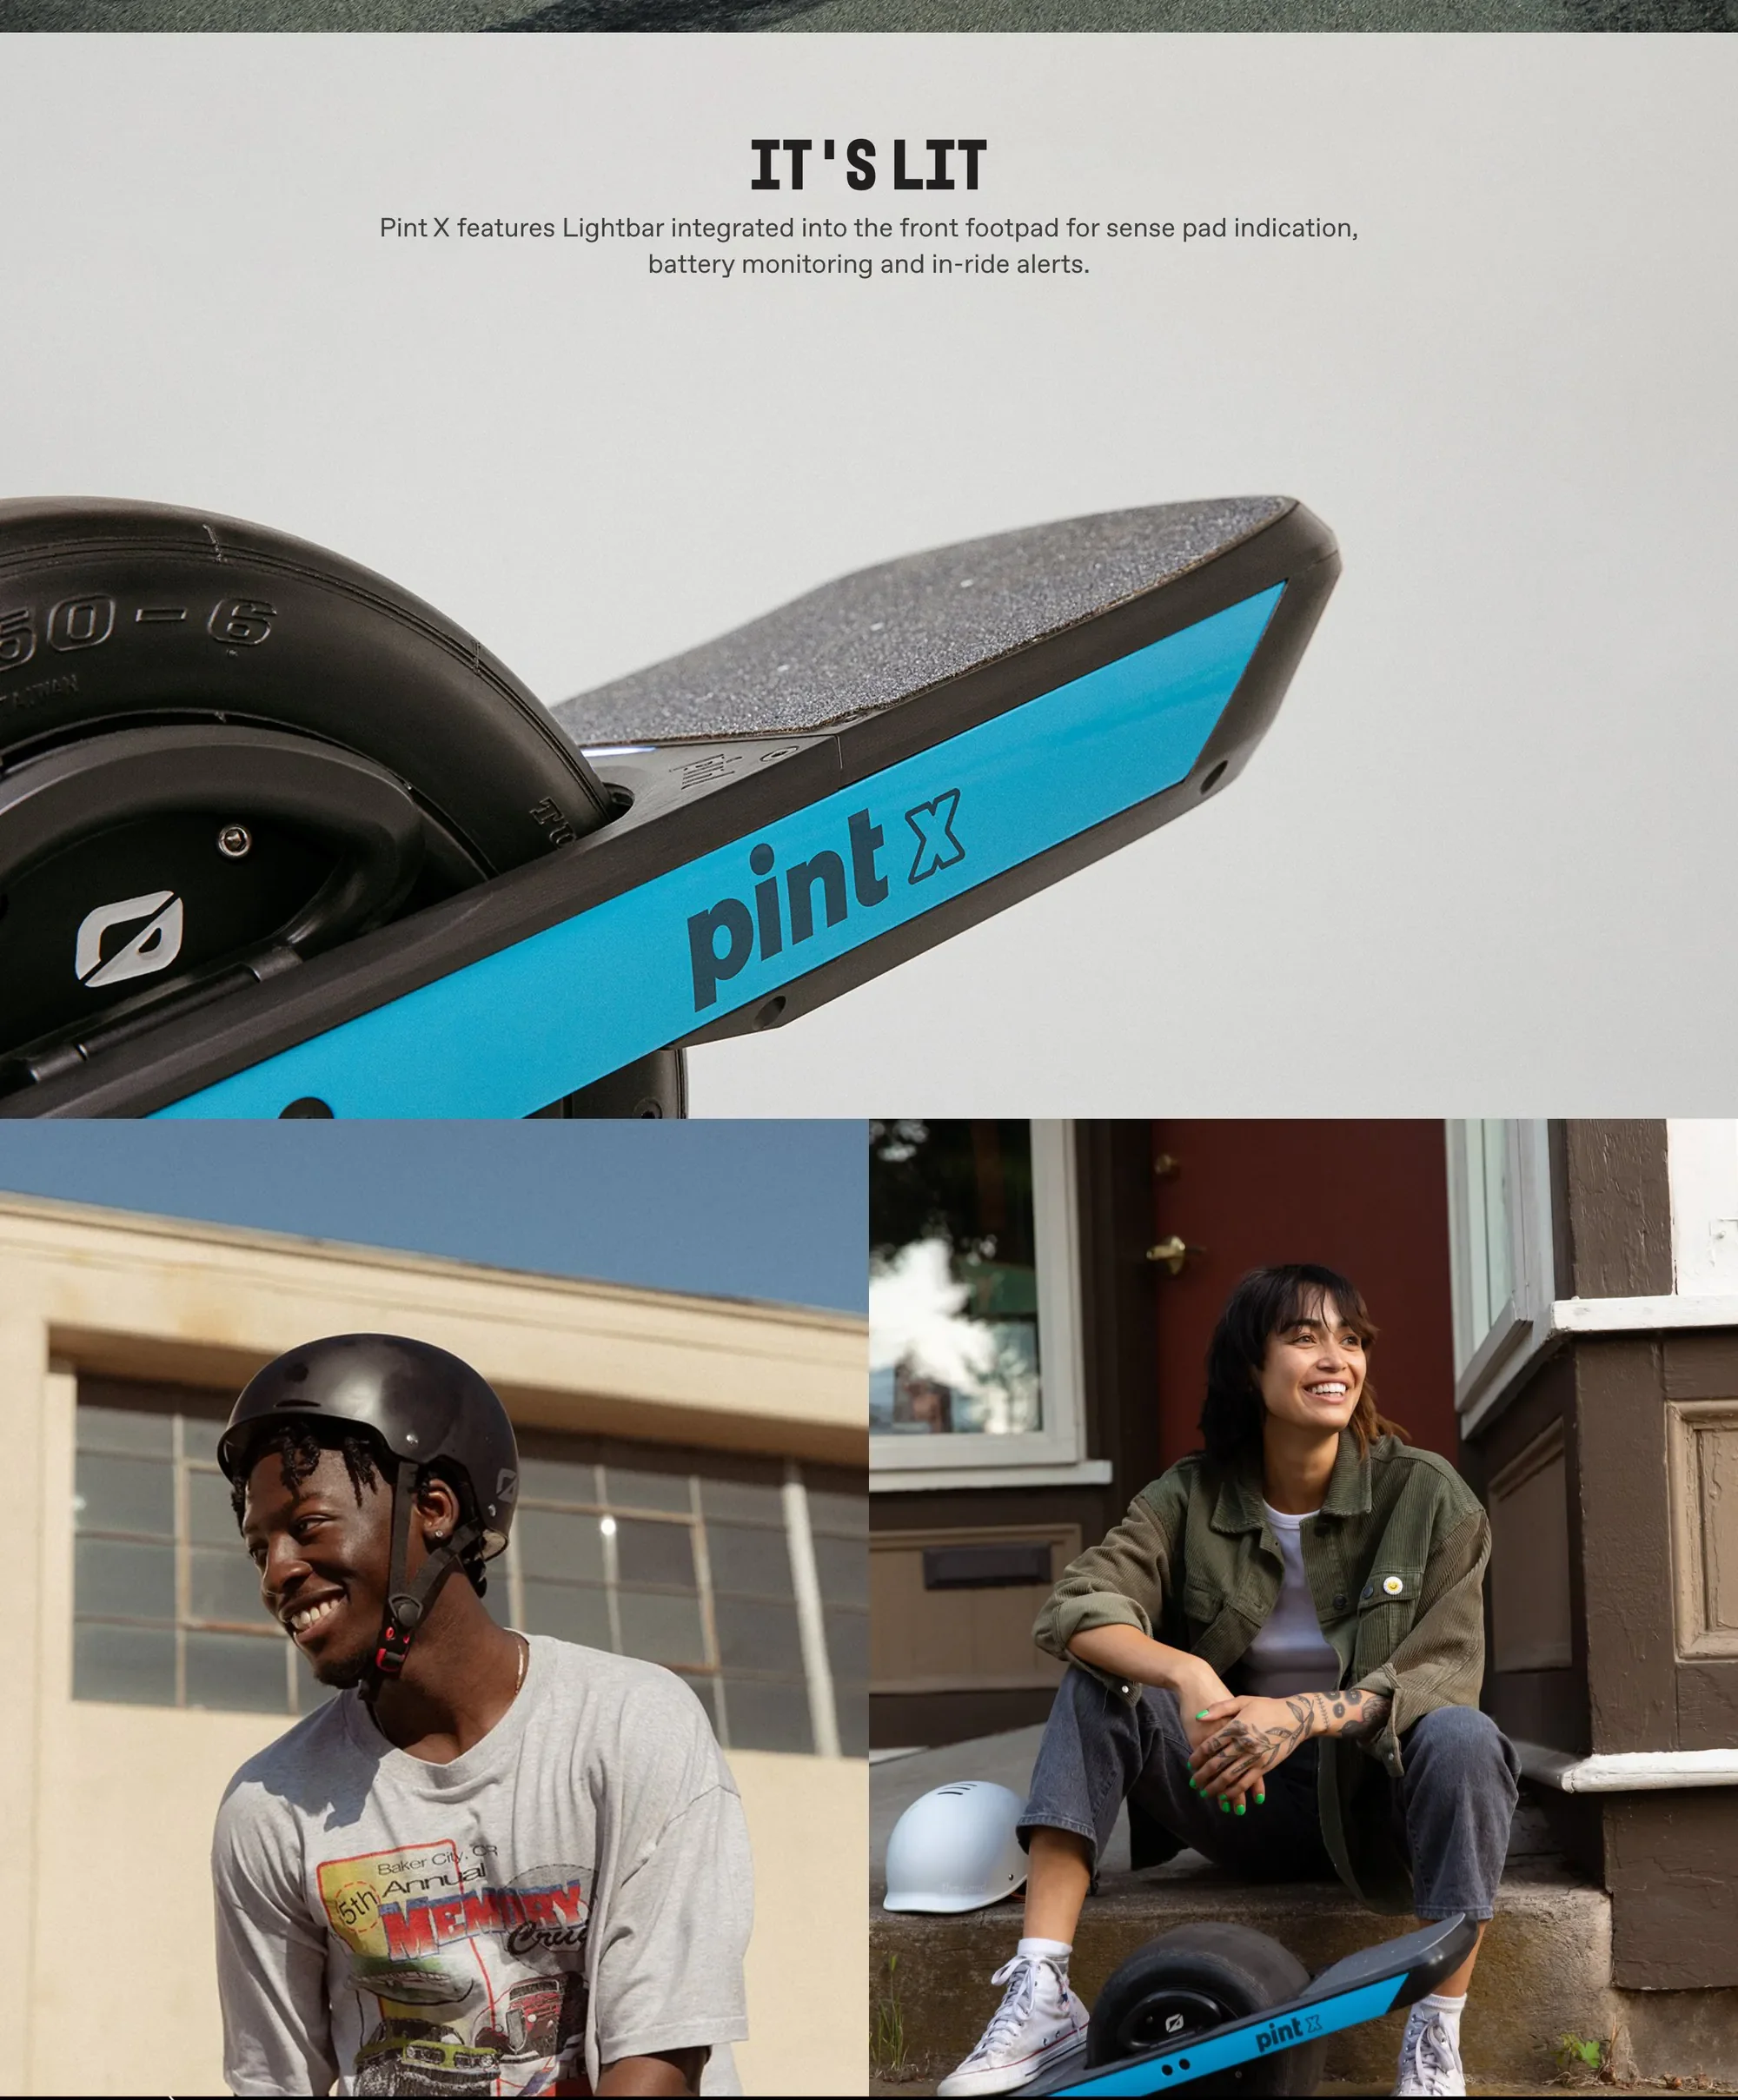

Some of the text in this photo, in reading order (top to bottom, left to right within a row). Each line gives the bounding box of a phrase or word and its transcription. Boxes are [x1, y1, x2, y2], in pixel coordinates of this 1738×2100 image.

[687, 807, 890, 1014] pint
[338, 1862, 487, 1926] 5th Annual
[377, 1858, 428, 1877] Baker
[378, 1878, 584, 1963] MEMORY
[1256, 2017, 1304, 2053] pint
